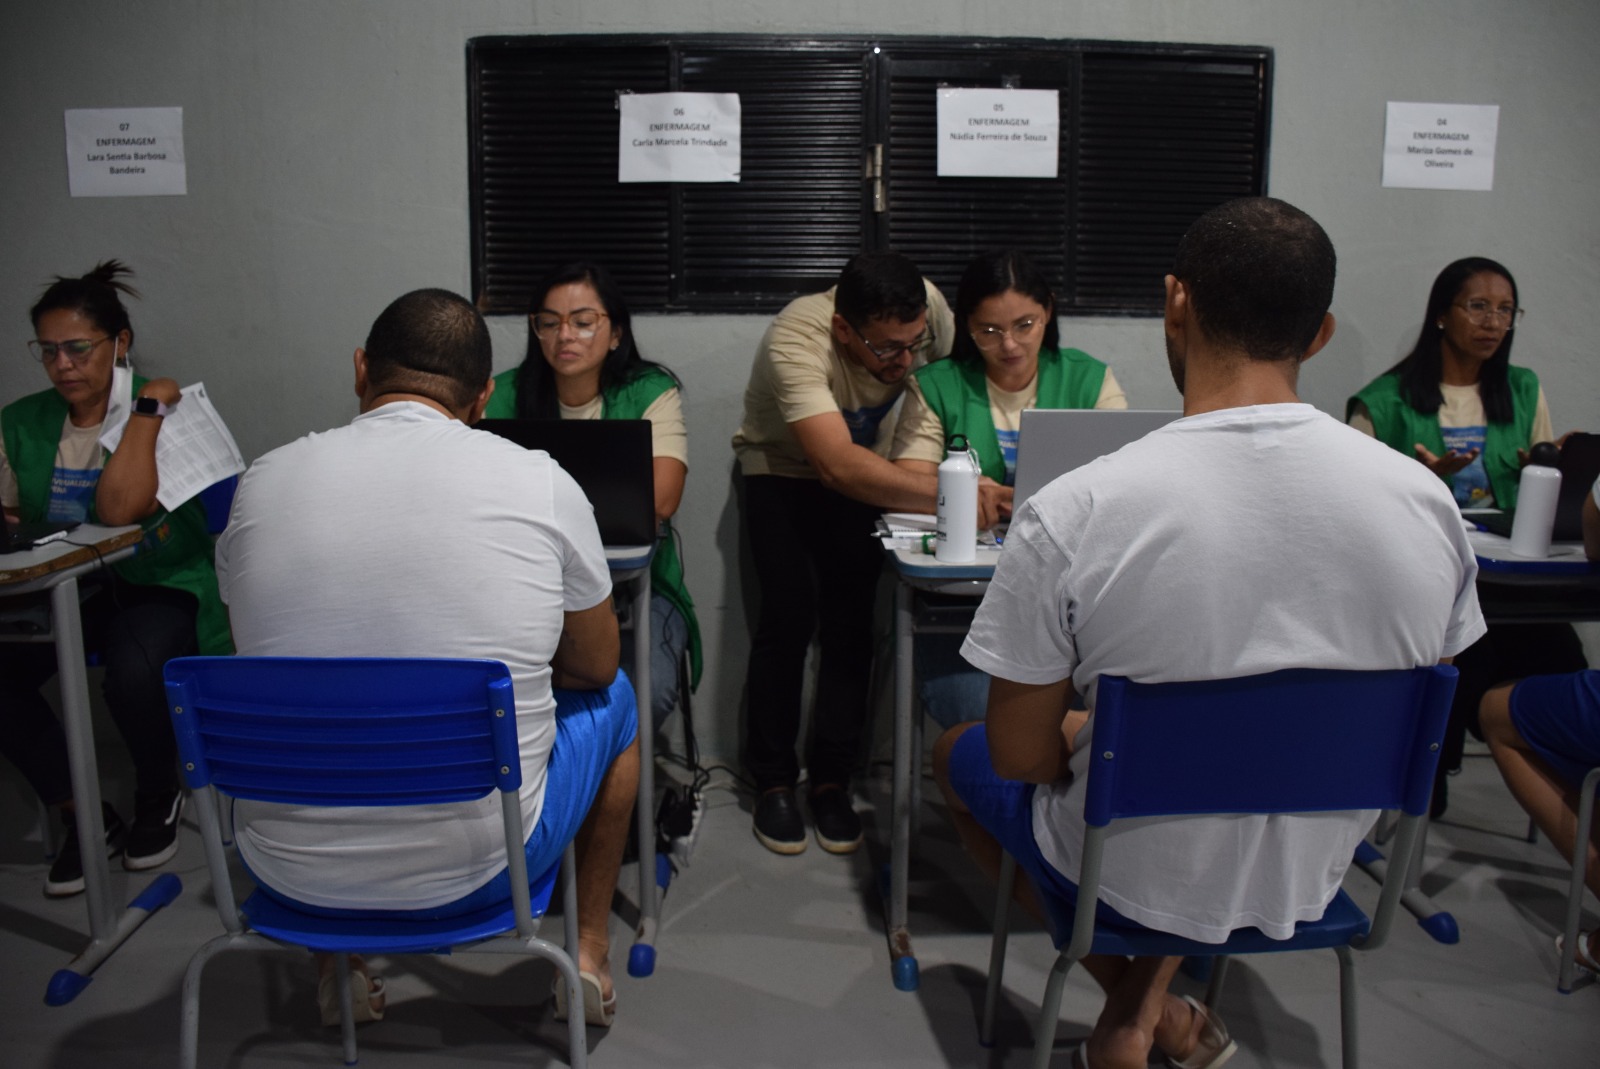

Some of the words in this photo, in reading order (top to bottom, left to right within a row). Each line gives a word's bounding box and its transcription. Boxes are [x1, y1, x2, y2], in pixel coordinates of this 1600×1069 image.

[673, 108, 685, 116] 06
[993, 104, 1004, 112] 05
[968, 118, 1029, 126] ENFERMAGEM
[1437, 118, 1447, 126] 04
[118, 123, 130, 131] 07
[650, 123, 710, 132] ENFERMAGEM
[976, 133, 1009, 141] Ferreira
[1010, 133, 1021, 141] de
[1024, 134, 1047, 142] Souza
[1413, 131, 1470, 141] ENFERMAGEM
[96, 137, 156, 147] ENFERMAGEM
[632, 139, 653, 147] Carla
[655, 138, 689, 146] Marcela
[691, 138, 728, 146] Trindade
[1435, 147, 1461, 155] Gomes
[1463, 148, 1473, 156] de
[87, 154, 104, 162] Lara
[1424, 160, 1454, 168] Oliveira
[109, 166, 145, 174] Bandeira
